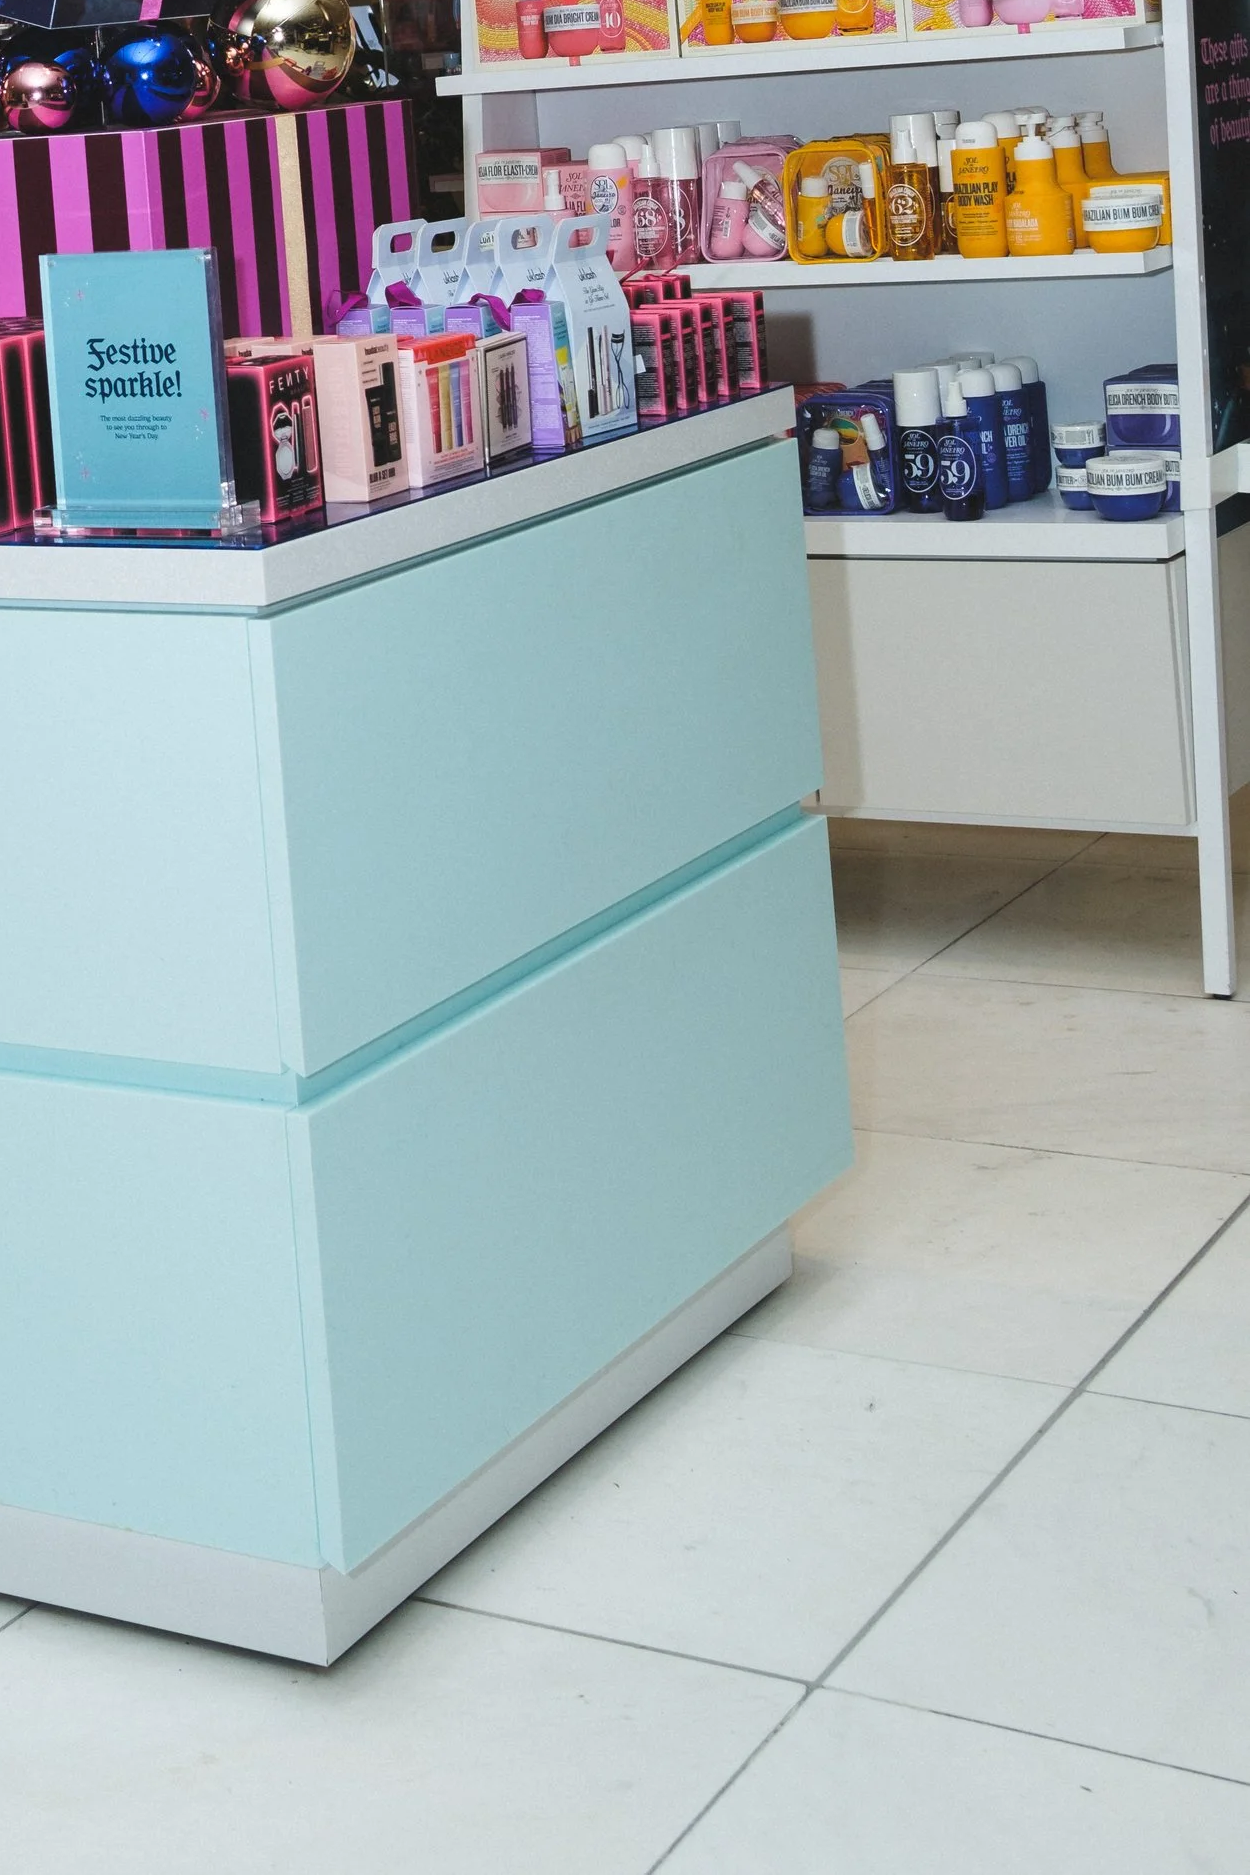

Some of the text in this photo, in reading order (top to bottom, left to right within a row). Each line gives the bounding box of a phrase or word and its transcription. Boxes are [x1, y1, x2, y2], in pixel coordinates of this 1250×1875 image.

[1205, 82, 1219, 105] are
[1222, 81, 1228, 101] a
[1210, 118, 1220, 150] of
[565, 172, 582, 182] SOL
[983, 181, 998, 194] PLAY
[890, 197, 914, 215] 62
[958, 194, 994, 206] BODY WASH
[634, 209, 657, 227] 68
[1112, 207, 1130, 220] BUM
[1132, 205, 1147, 218] BUM
[86, 337, 177, 372] Festive
[85, 370, 182, 404] sparkle!
[269, 366, 309, 394] FENTY
[1122, 393, 1162, 405] DRENCH BODY
[127, 415, 151, 423] dazzling
[152, 415, 172, 423] beauty
[136, 424, 160, 432] through
[147, 432, 159, 440] Day
[940, 447, 965, 455] JANEIRO
[904, 454, 934, 479] 59
[941, 460, 971, 485] 59
[1107, 469, 1164, 486] BUM BUM CREAM
